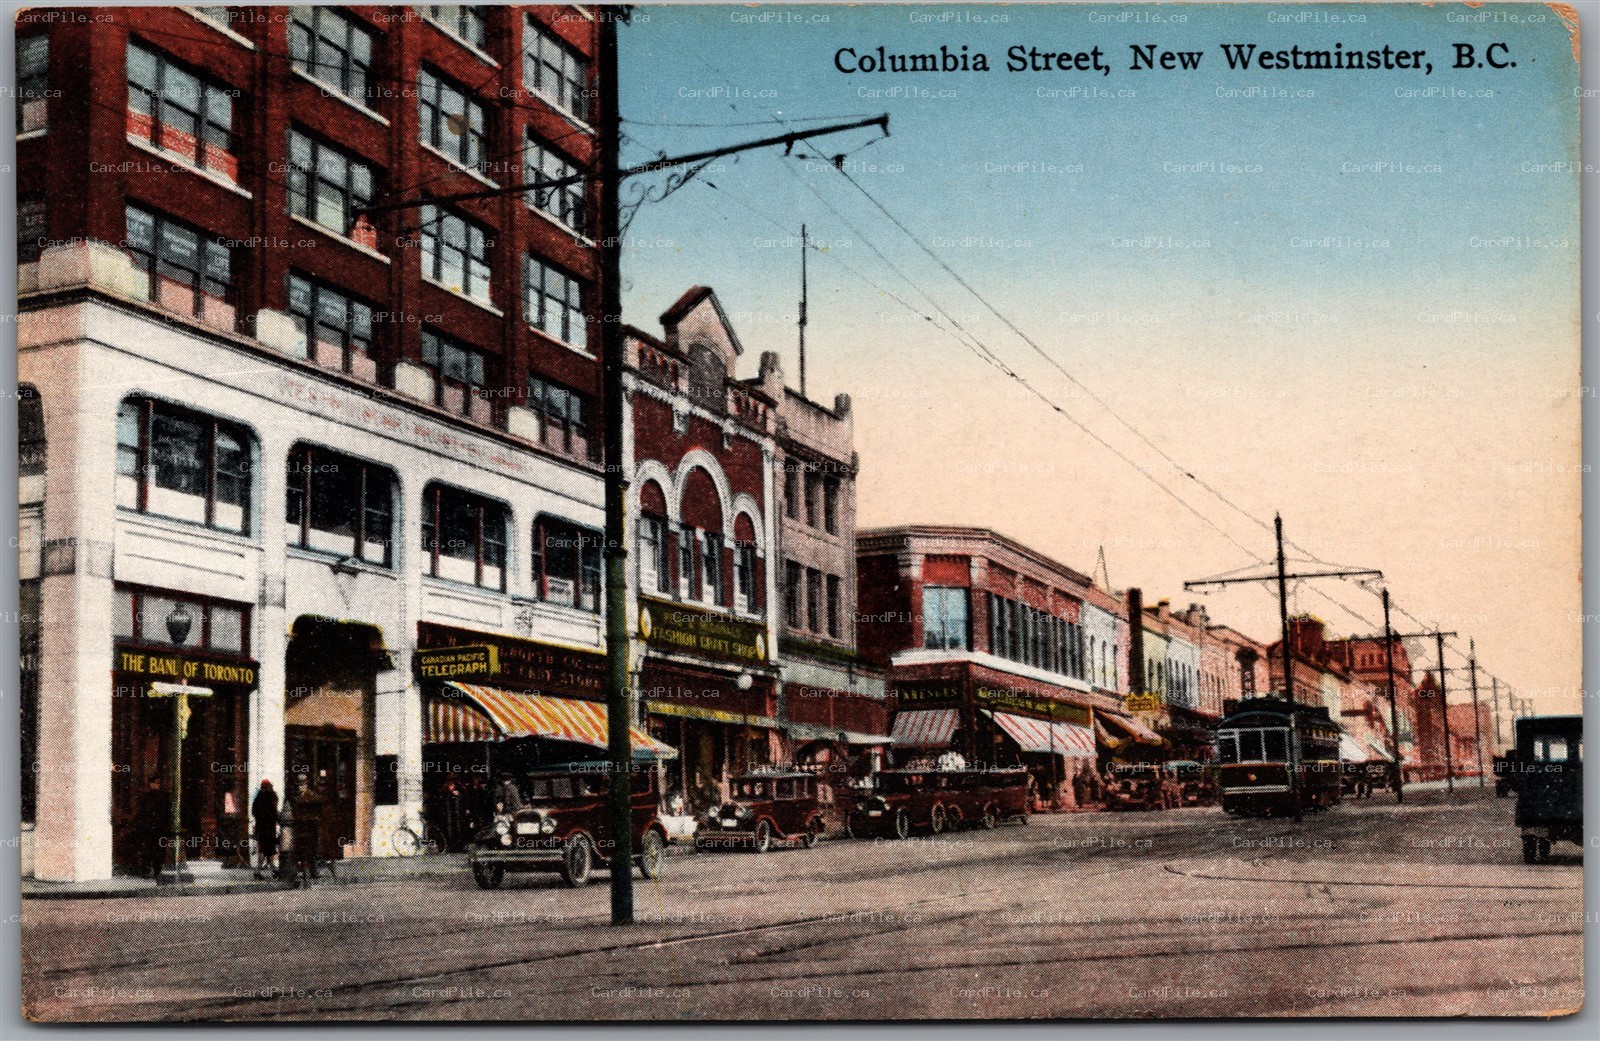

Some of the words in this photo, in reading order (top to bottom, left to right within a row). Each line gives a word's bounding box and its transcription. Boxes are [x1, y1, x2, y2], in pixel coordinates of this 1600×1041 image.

[421, 654, 456, 665] CANADIAN
[121, 652, 145, 673] THE
[183, 660, 199, 678] OF
[203, 662, 254, 685] TORONTO
[421, 661, 487, 677] TELEGRAPH
